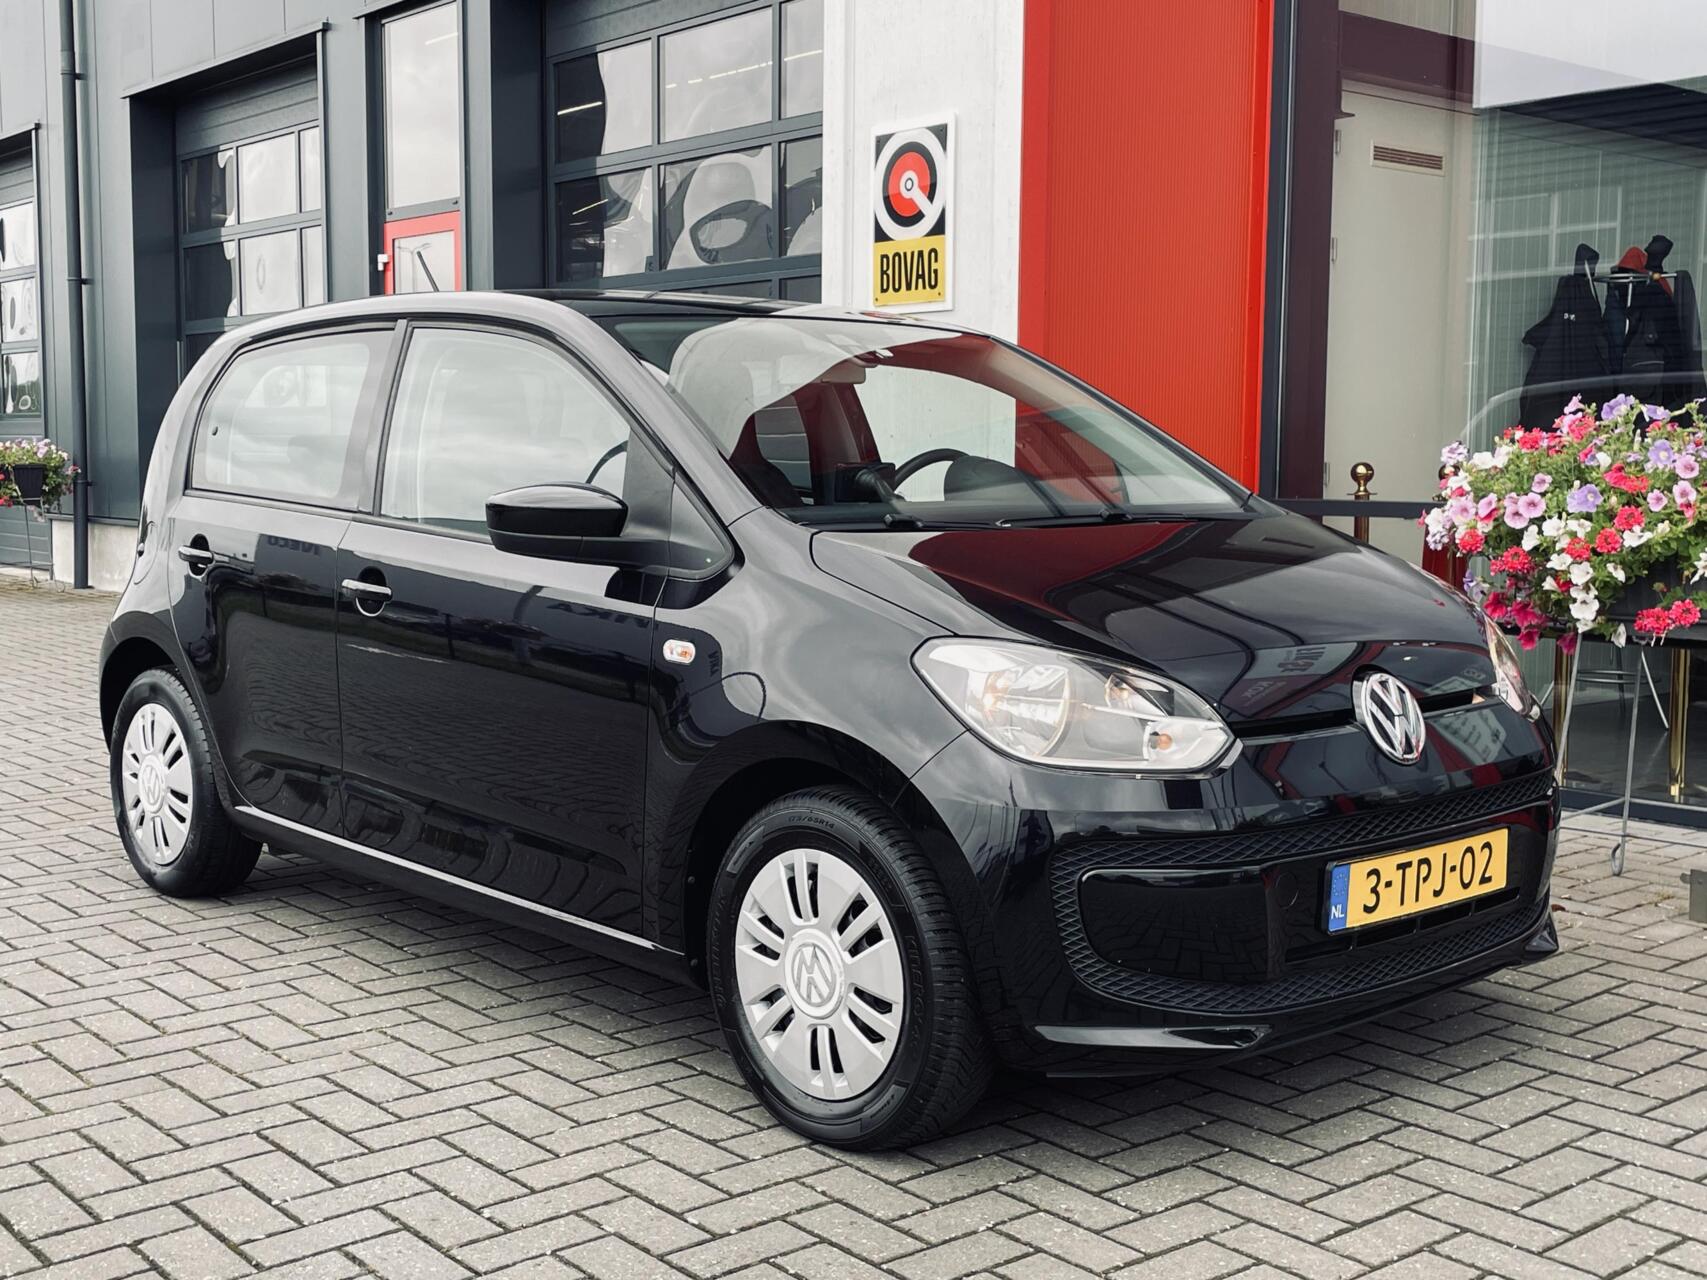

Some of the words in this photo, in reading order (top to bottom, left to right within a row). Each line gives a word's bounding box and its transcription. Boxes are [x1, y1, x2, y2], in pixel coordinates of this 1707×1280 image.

[880, 247, 939, 294] BOVAG
[1362, 674, 1425, 764] VW
[1362, 841, 1493, 914] 3-TPJ-02
[1330, 903, 1345, 920] NL
